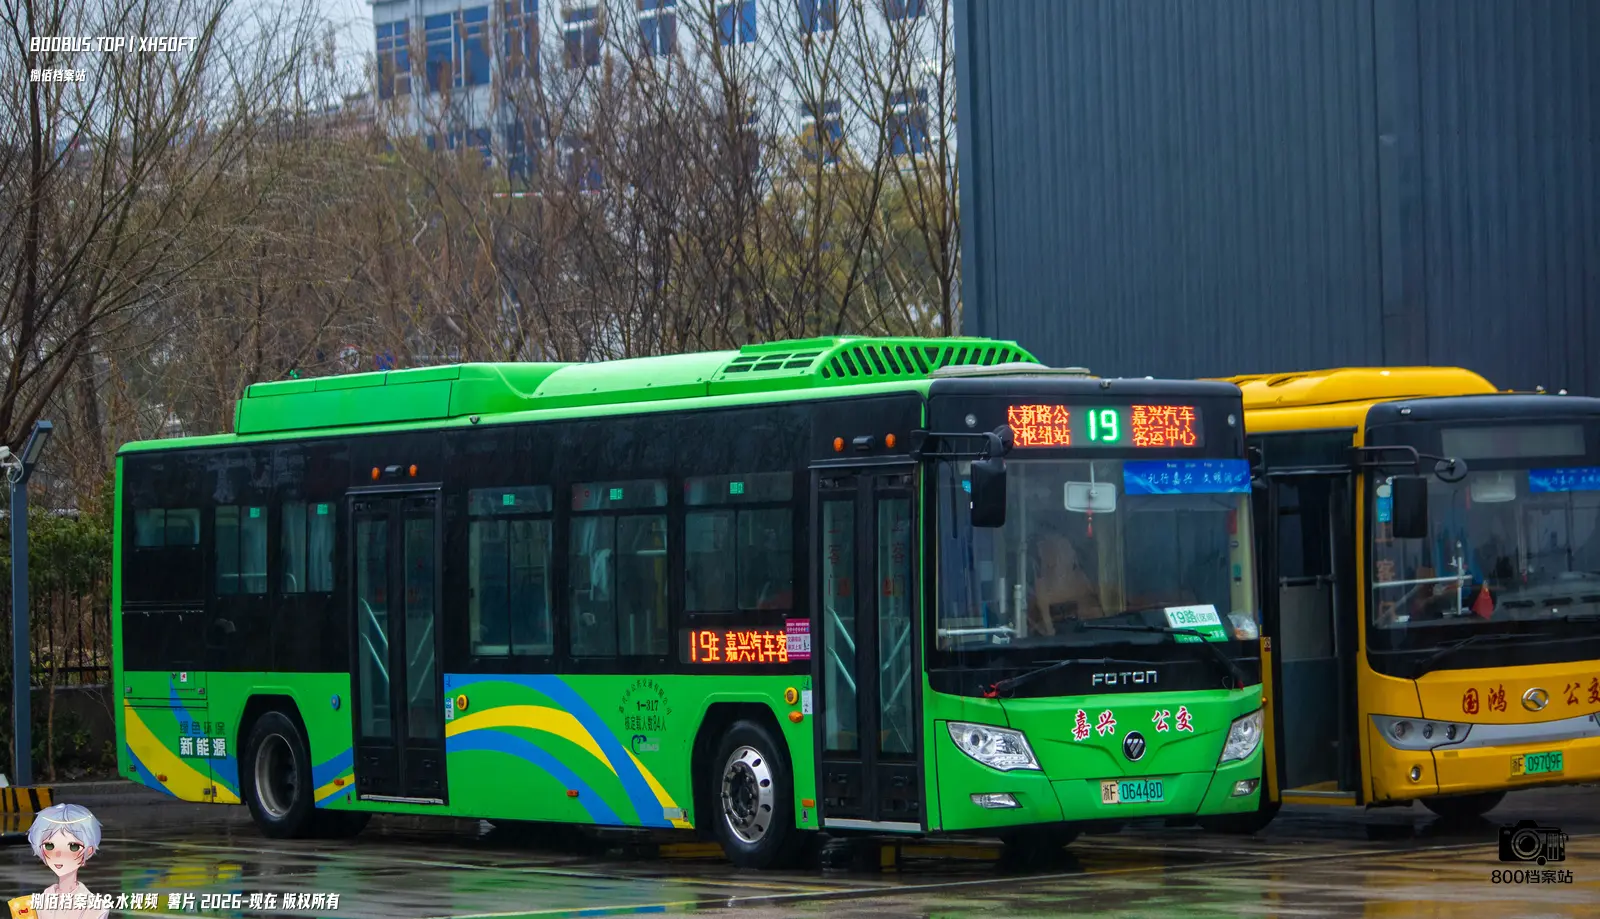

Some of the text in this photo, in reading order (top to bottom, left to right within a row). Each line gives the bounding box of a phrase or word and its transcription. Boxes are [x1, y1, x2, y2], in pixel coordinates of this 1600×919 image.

[1087, 409, 1120, 442] 19
[1131, 405, 1196, 426] 嘉兴汽车
[1131, 425, 1196, 447] 客运中心
[724, 630, 788, 662] 嘉兴汽车客
[1092, 670, 1158, 686] FOTON
[636, 699, 659, 712] 1-317
[179, 720, 225, 735] 绿色环保
[1072, 706, 1194, 741] 嘉兴 公交
[179, 736, 226, 757] 新能源
